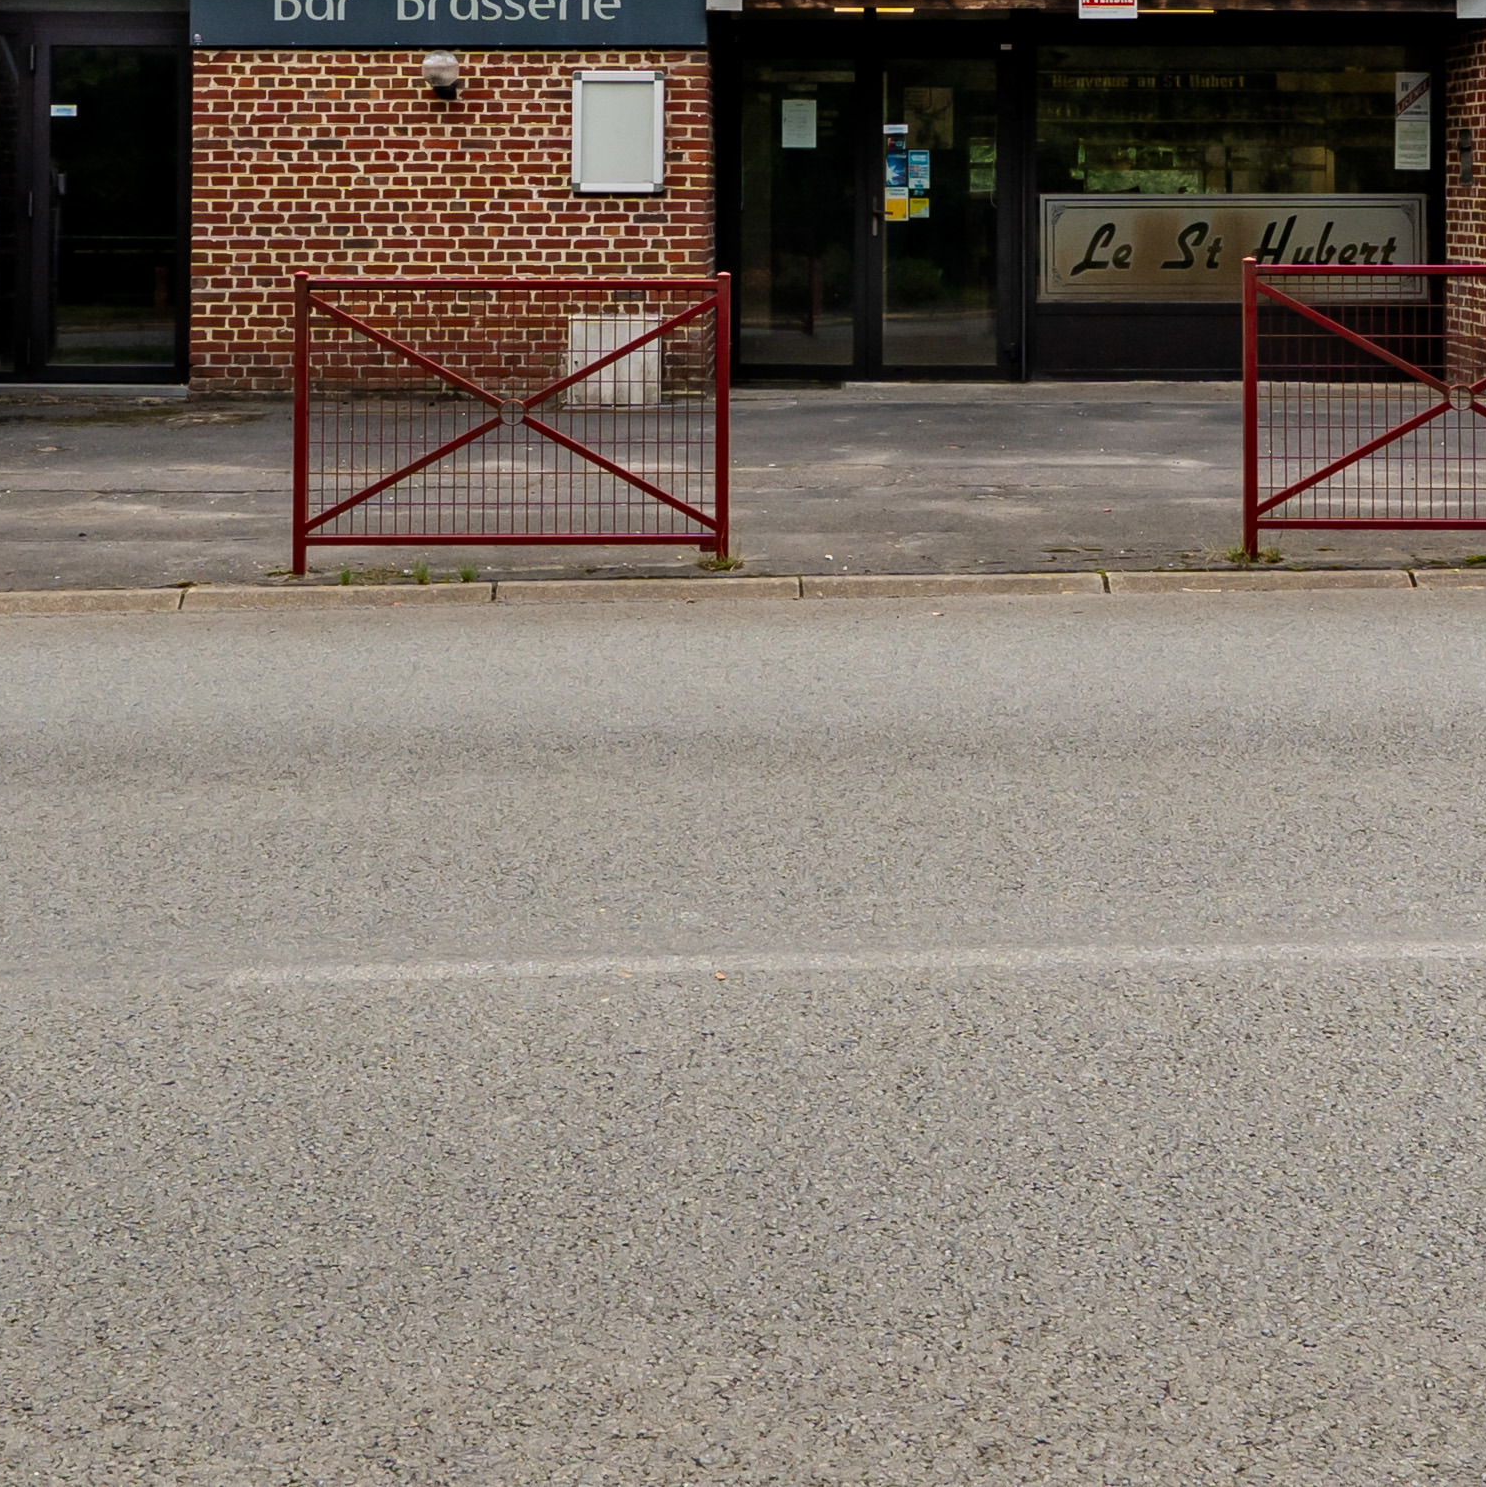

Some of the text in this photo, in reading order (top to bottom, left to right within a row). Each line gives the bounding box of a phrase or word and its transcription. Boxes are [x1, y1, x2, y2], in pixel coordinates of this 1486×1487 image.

[1070, 214, 1398, 277] Le St Hubert
